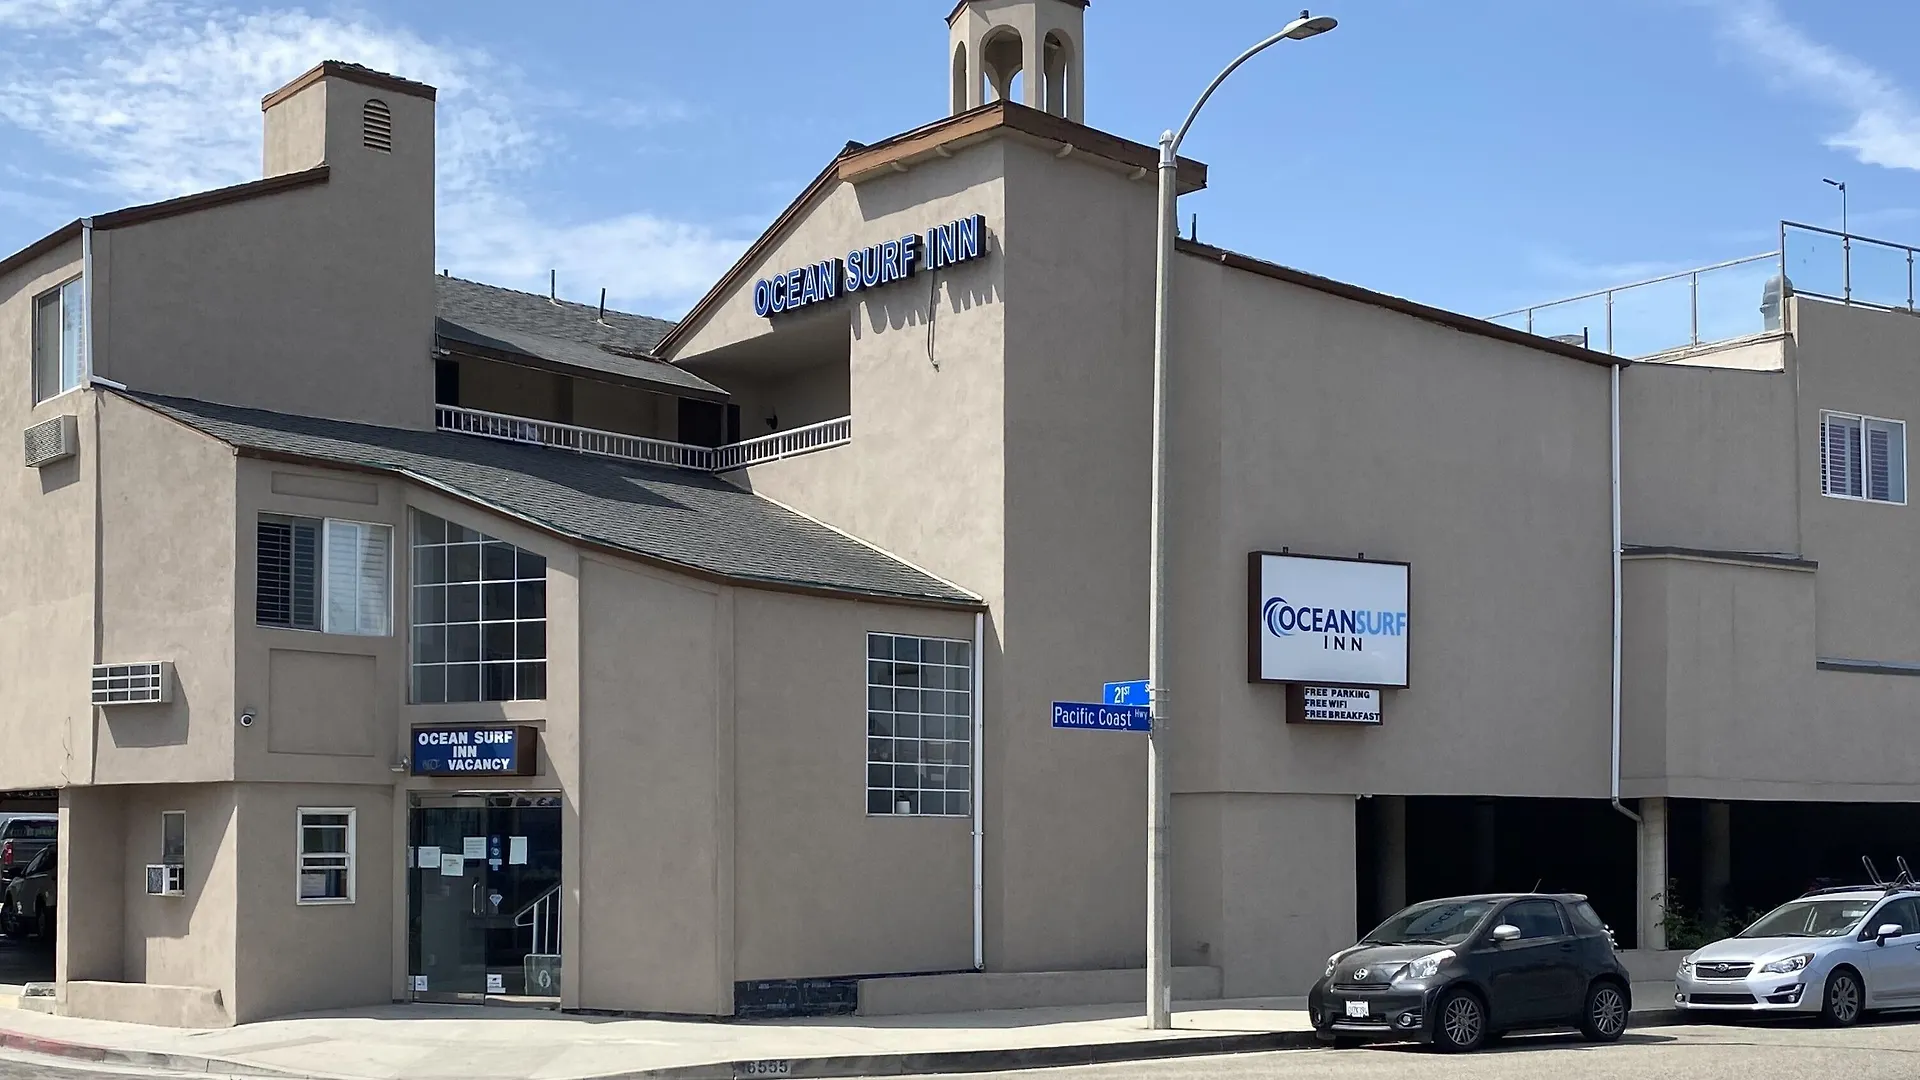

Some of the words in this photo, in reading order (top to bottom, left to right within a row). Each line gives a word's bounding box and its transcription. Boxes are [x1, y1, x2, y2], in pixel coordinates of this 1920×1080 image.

[754, 257, 838, 318] OCEAN
[846, 233, 918, 293] SURF
[925, 213, 981, 271] INN
[1324, 635, 1362, 651] INN
[1304, 687, 1328, 697] FREE
[1330, 688, 1370, 699] PARKING
[1304, 698, 1327, 708] FREE
[1328, 699, 1348, 709] WIFI
[1054, 706, 1095, 725] Pacific
[1098, 708, 1132, 727] Coast
[1134, 708, 1148, 720] Hwy
[1304, 709, 1327, 719] FREE
[1328, 710, 1380, 721] BREAKFAST
[418, 731, 468, 746] OCEAN
[474, 730, 514, 744] SURF
[452, 745, 477, 758] INN
[447, 758, 511, 771] VACANCY
[747, 1060, 788, 1073] 6555
